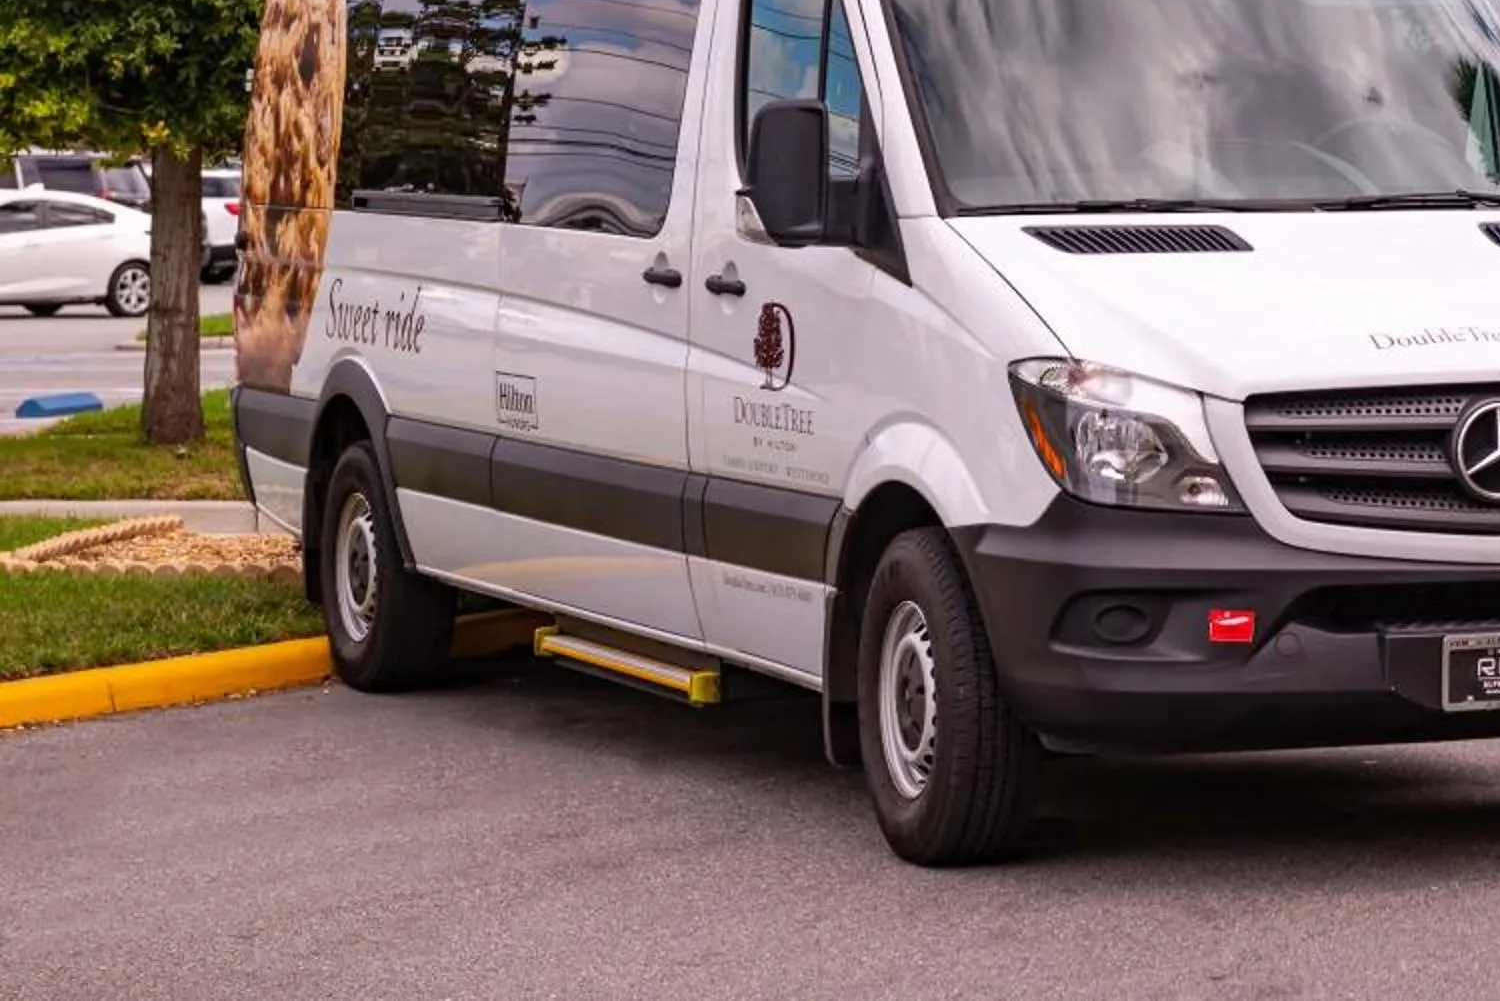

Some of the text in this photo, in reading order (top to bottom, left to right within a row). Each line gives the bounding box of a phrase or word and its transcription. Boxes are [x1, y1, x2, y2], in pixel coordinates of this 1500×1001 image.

[325, 278, 426, 354] Sweet ride
[499, 382, 534, 414] Hilton
[733, 396, 816, 435] DOUBLETREE
